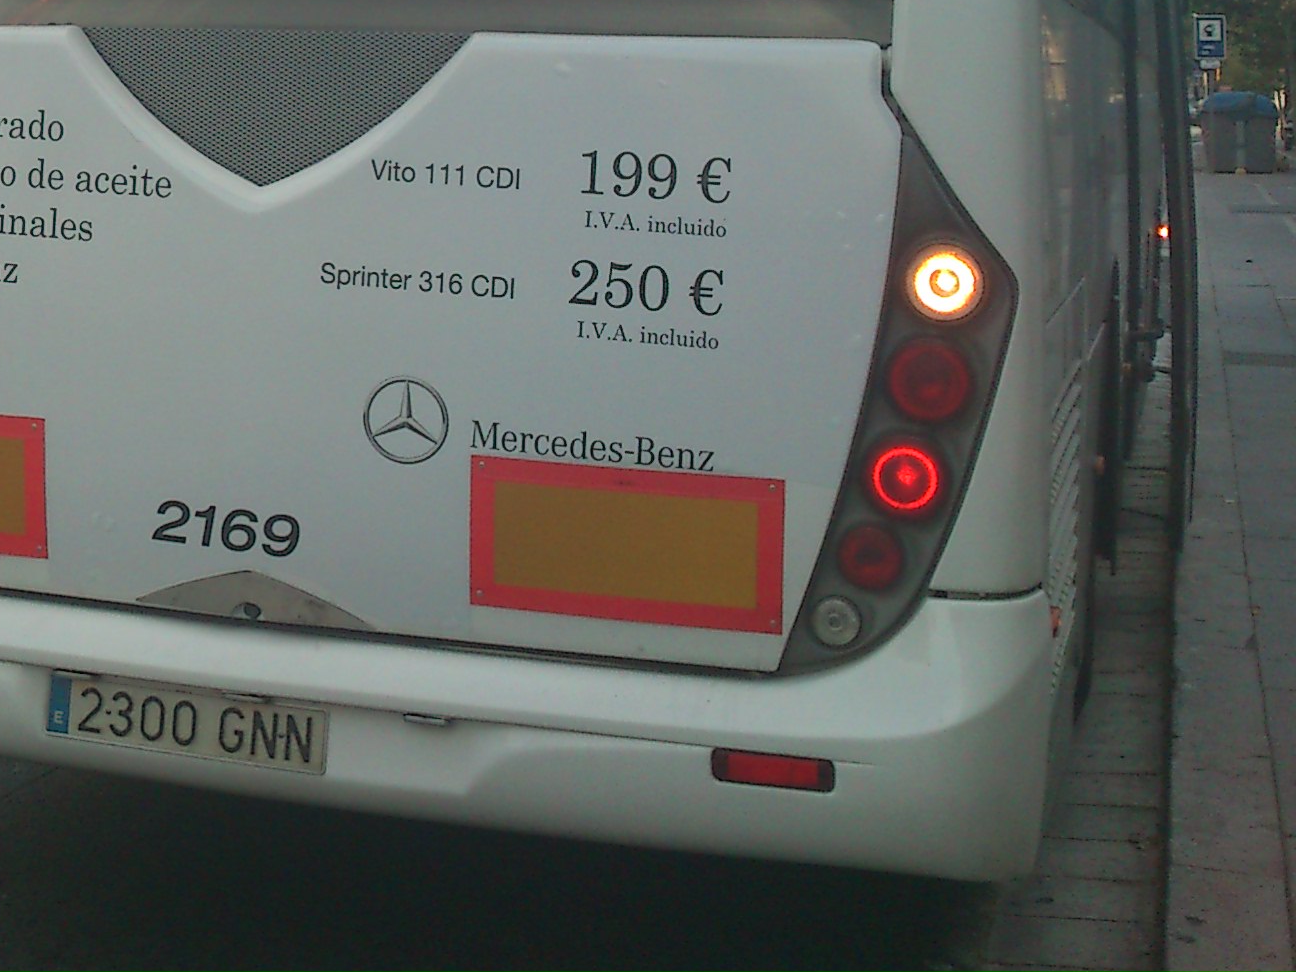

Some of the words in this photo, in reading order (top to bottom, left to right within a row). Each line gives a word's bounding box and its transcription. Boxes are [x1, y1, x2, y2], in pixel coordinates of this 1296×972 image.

[28, 157, 65, 191] de
[74, 164, 173, 199] aceite
[371, 158, 415, 183] Vito
[425, 163, 465, 187] 111
[476, 165, 521, 191] CDI
[580, 149, 678, 200] 199
[696, 157, 732, 204] €
[584, 210, 641, 232] I.V.A.
[647, 216, 727, 238] incluido
[320, 262, 412, 292] Sprinter
[419, 270, 463, 296] 316
[471, 274, 515, 300] CDI
[568, 259, 670, 313] 250
[688, 268, 725, 317] €
[577, 320, 634, 344] I.V.A.
[639, 326, 720, 350] incluido
[470, 419, 716, 472] Mercedes-Benz
[151, 499, 301, 558] 2169
[54, 711, 64, 725] E
[78, 687, 197, 746] 2300
[218, 707, 313, 764] GNN
